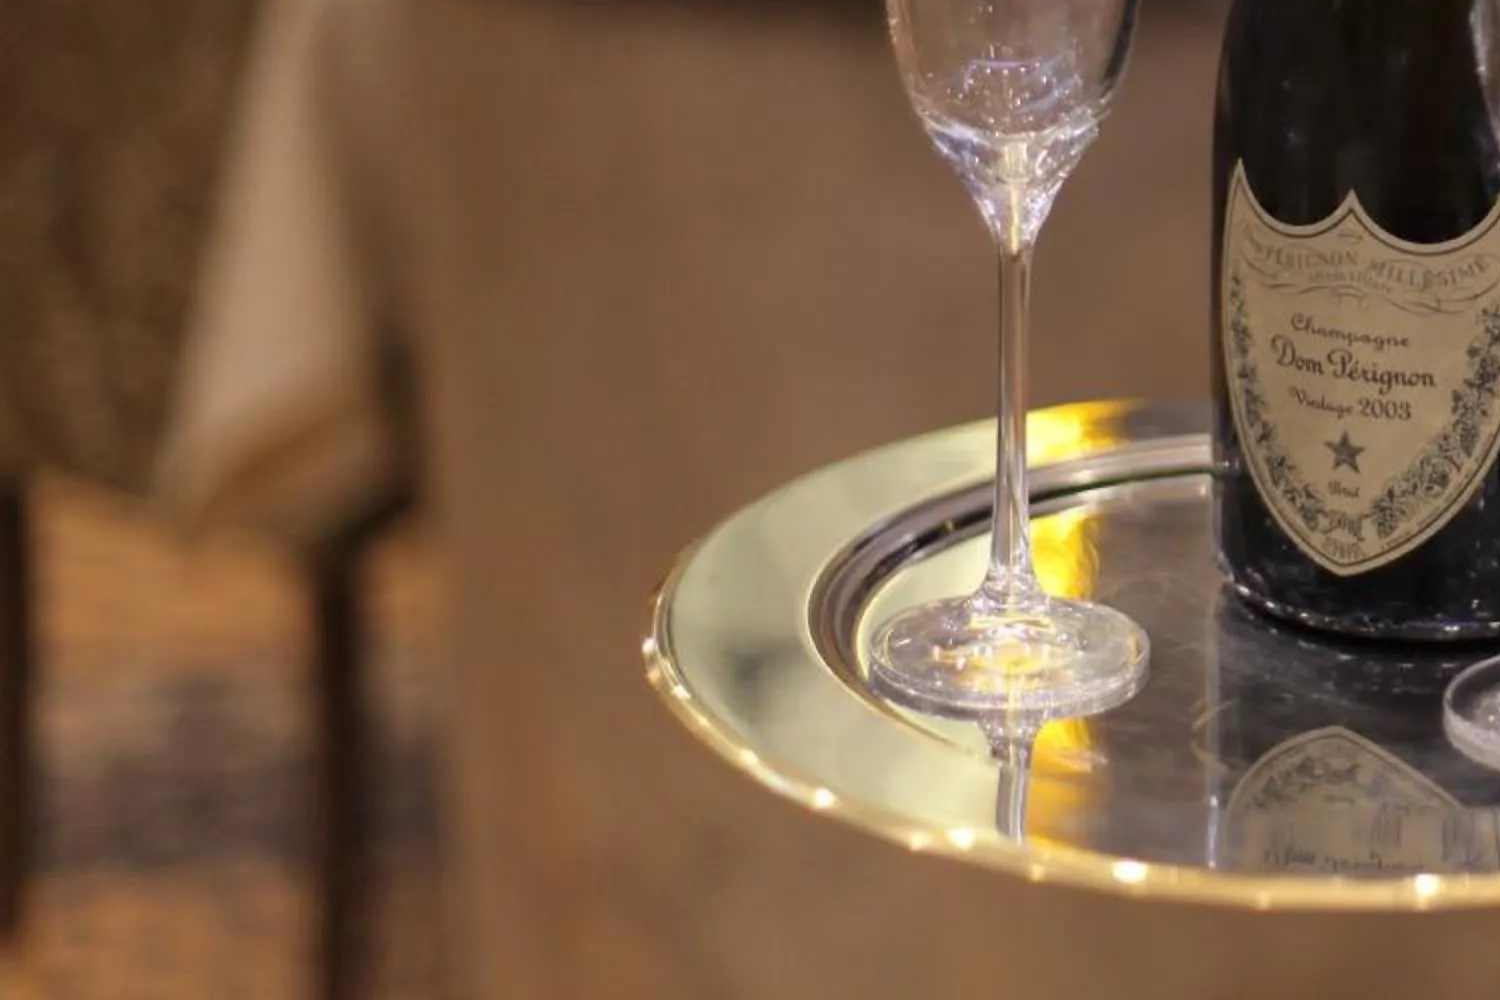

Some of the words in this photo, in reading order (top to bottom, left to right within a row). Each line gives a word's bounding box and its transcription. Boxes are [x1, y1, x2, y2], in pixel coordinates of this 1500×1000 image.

[1291, 312, 1410, 350] Champagne
[1271, 334, 1325, 376] Dom
[1327, 349, 1437, 395] Pérignon
[1289, 385, 1353, 420] Vintage
[1359, 397, 1412, 421] 2003
